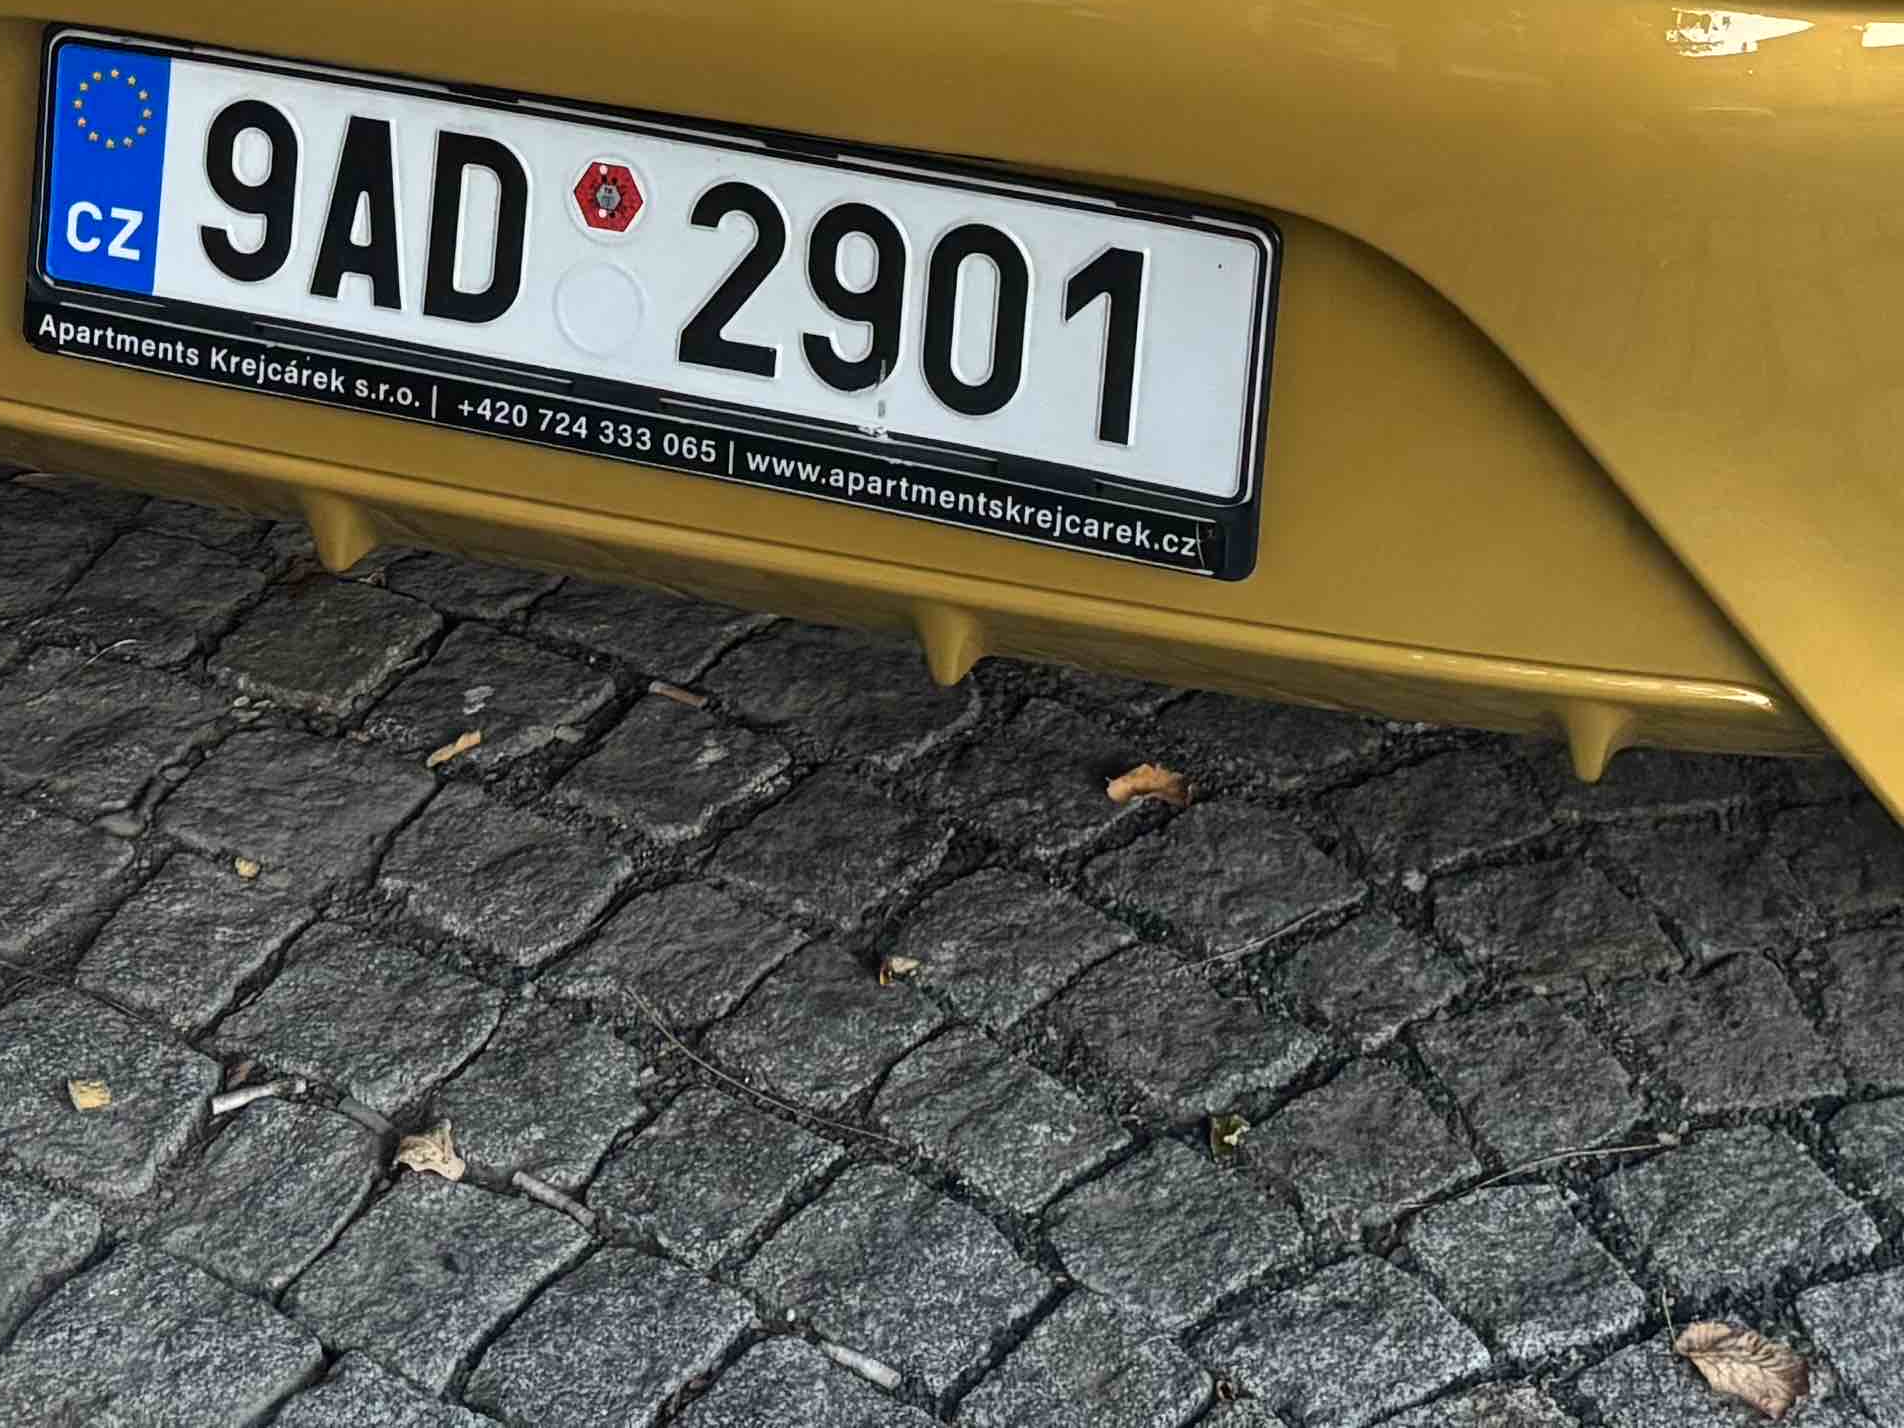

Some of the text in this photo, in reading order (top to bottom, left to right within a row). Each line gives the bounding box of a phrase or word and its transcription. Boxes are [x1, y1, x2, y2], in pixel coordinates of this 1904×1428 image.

[65, 199, 145, 262] CZ
[198, 98, 1146, 447] 9AD 2901
[38, 313, 200, 367] Apartments
[209, 345, 346, 395] Krejcárek
[354, 377, 421, 408] s.r.o.
[456, 396, 529, 429] +420
[537, 408, 590, 440] 724
[598, 420, 653, 452] 333
[662, 432, 718, 463] 065
[746, 449, 1197, 558] www.apartmentskrejcarek.cz
